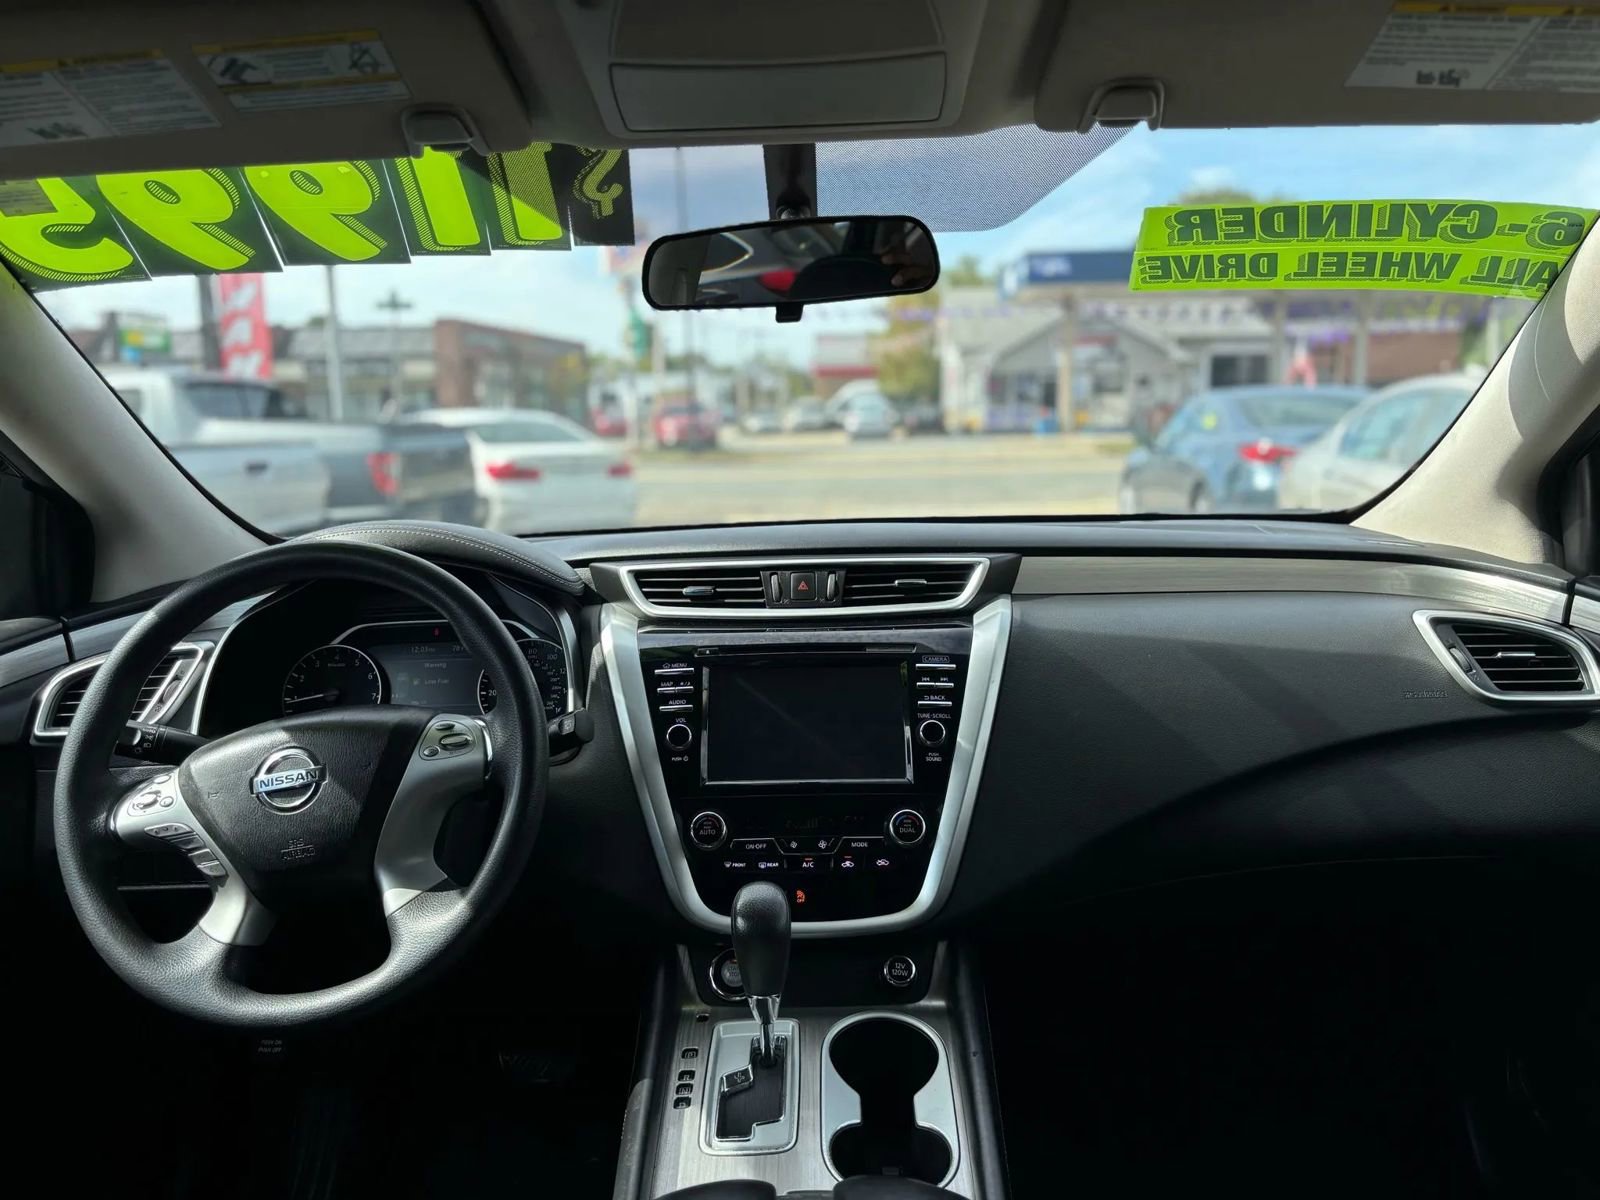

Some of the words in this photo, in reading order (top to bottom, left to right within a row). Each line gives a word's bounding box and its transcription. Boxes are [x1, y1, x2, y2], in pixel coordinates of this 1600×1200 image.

[354, 658, 360, 666] 5
[367, 672, 373, 680] 6
[259, 770, 318, 788] NISSAN
[891, 968, 909, 976] 120W
